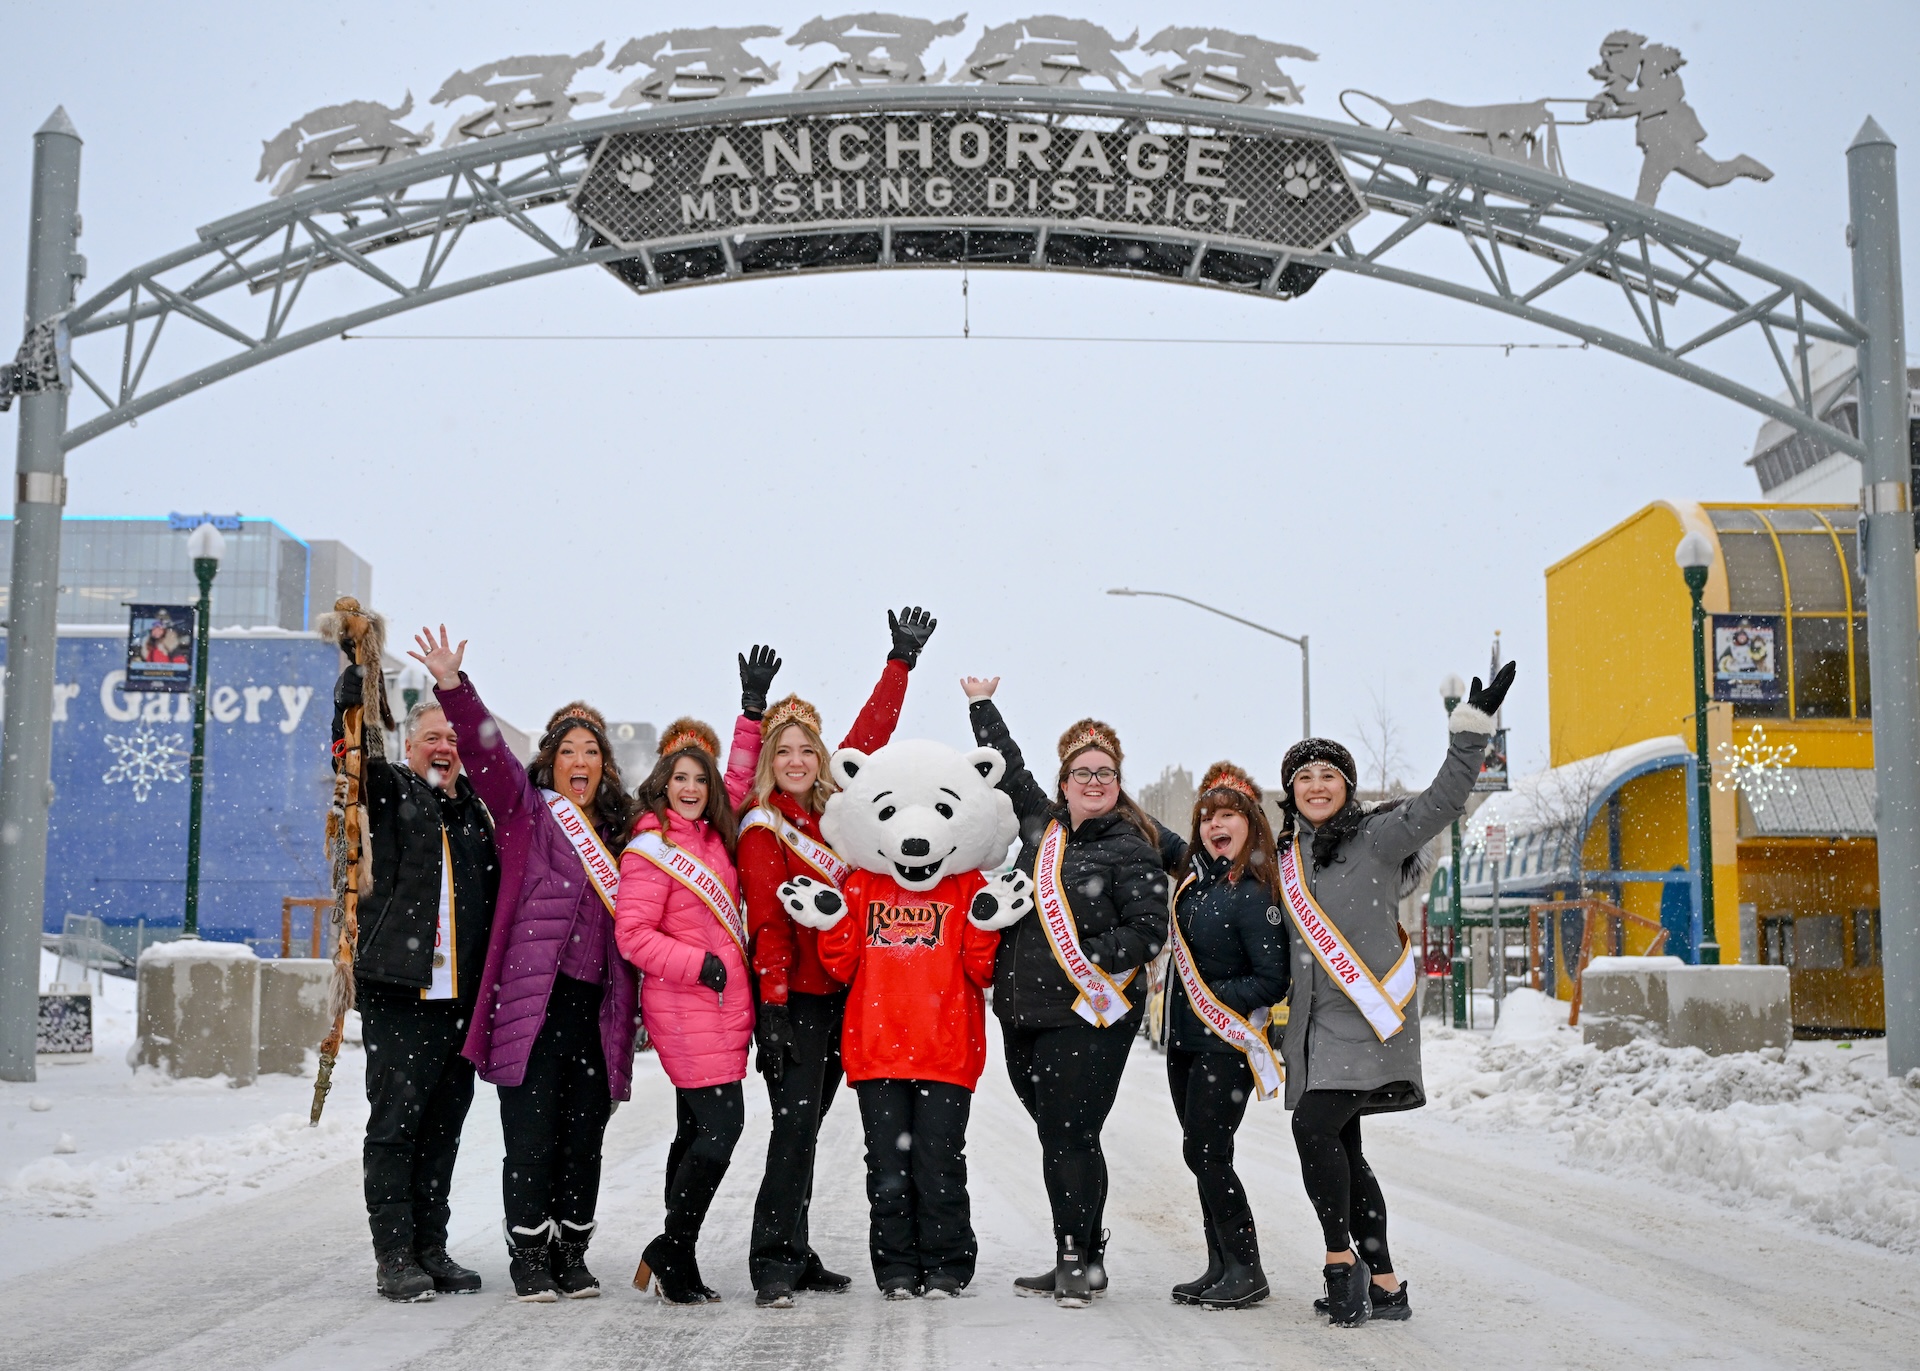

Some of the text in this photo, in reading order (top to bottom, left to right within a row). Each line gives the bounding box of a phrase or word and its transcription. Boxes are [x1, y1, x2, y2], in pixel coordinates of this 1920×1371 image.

[700, 122, 1230, 188] ANCHORAGE
[681, 176, 1247, 229] MUSHING DISTRICT
[101, 669, 314, 734] Galery
[557, 807, 619, 890] LADY TRAPPER
[669, 853, 696, 878] FUR
[812, 849, 835, 871] FUR
[1040, 837, 1056, 899] RENDEZVOUS
[866, 900, 954, 946] RONDY
[1045, 899, 1092, 979] SWEETHEART
[1287, 882, 1337, 956] AMBASSADOR
[1330, 952, 1360, 984] 2026
[1087, 979, 1105, 993] 2026
[1186, 977, 1230, 1030] PRINCESS
[1227, 1029, 1246, 1040] 2026
